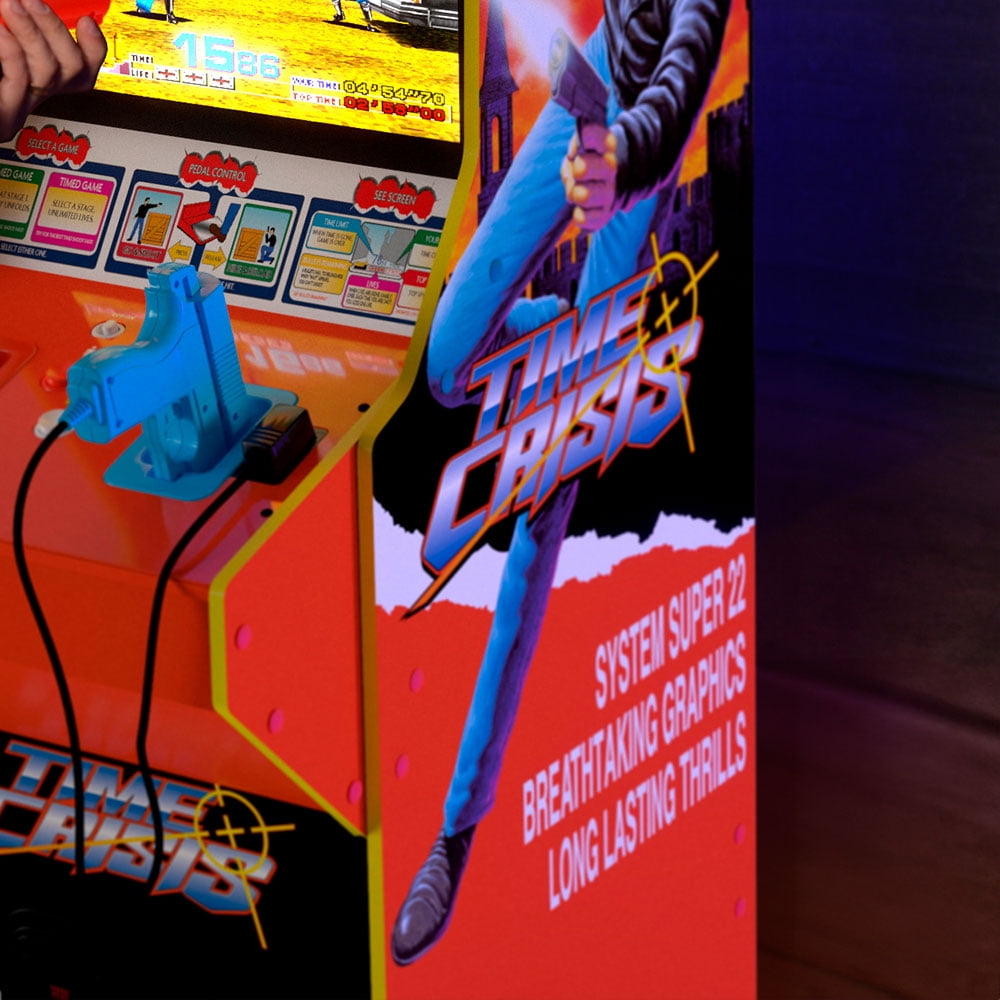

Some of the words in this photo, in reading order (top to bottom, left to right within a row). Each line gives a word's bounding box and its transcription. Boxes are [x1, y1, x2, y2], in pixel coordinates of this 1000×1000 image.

[27, 138, 51, 150] SELECT
[52, 143, 57, 151] A
[58, 143, 79, 155] GAME
[188, 164, 210, 176] PEDAL
[211, 167, 247, 182] CONTROL
[12, 169, 34, 181] GAME
[59, 177, 81, 189] TIMED
[81, 180, 104, 193] GAME
[373, 190, 387, 202] SEE
[388, 191, 416, 205] SCREEN
[51, 199, 72, 209] SELECT
[466, 267, 657, 446] TIME
[421, 315, 703, 576] CRISIS
[594, 604, 665, 710] SYSTEM
[668, 566, 724, 660] SUPER
[727, 553, 746, 619] 22
[522, 693, 658, 846] BREATHTAKING
[661, 631, 746, 745] GRAPHICS
[4, 739, 219, 834] TIME
[548, 817, 599, 911] LONG
[603, 762, 675, 871] LASTING
[678, 711, 746, 812] THRILLS
